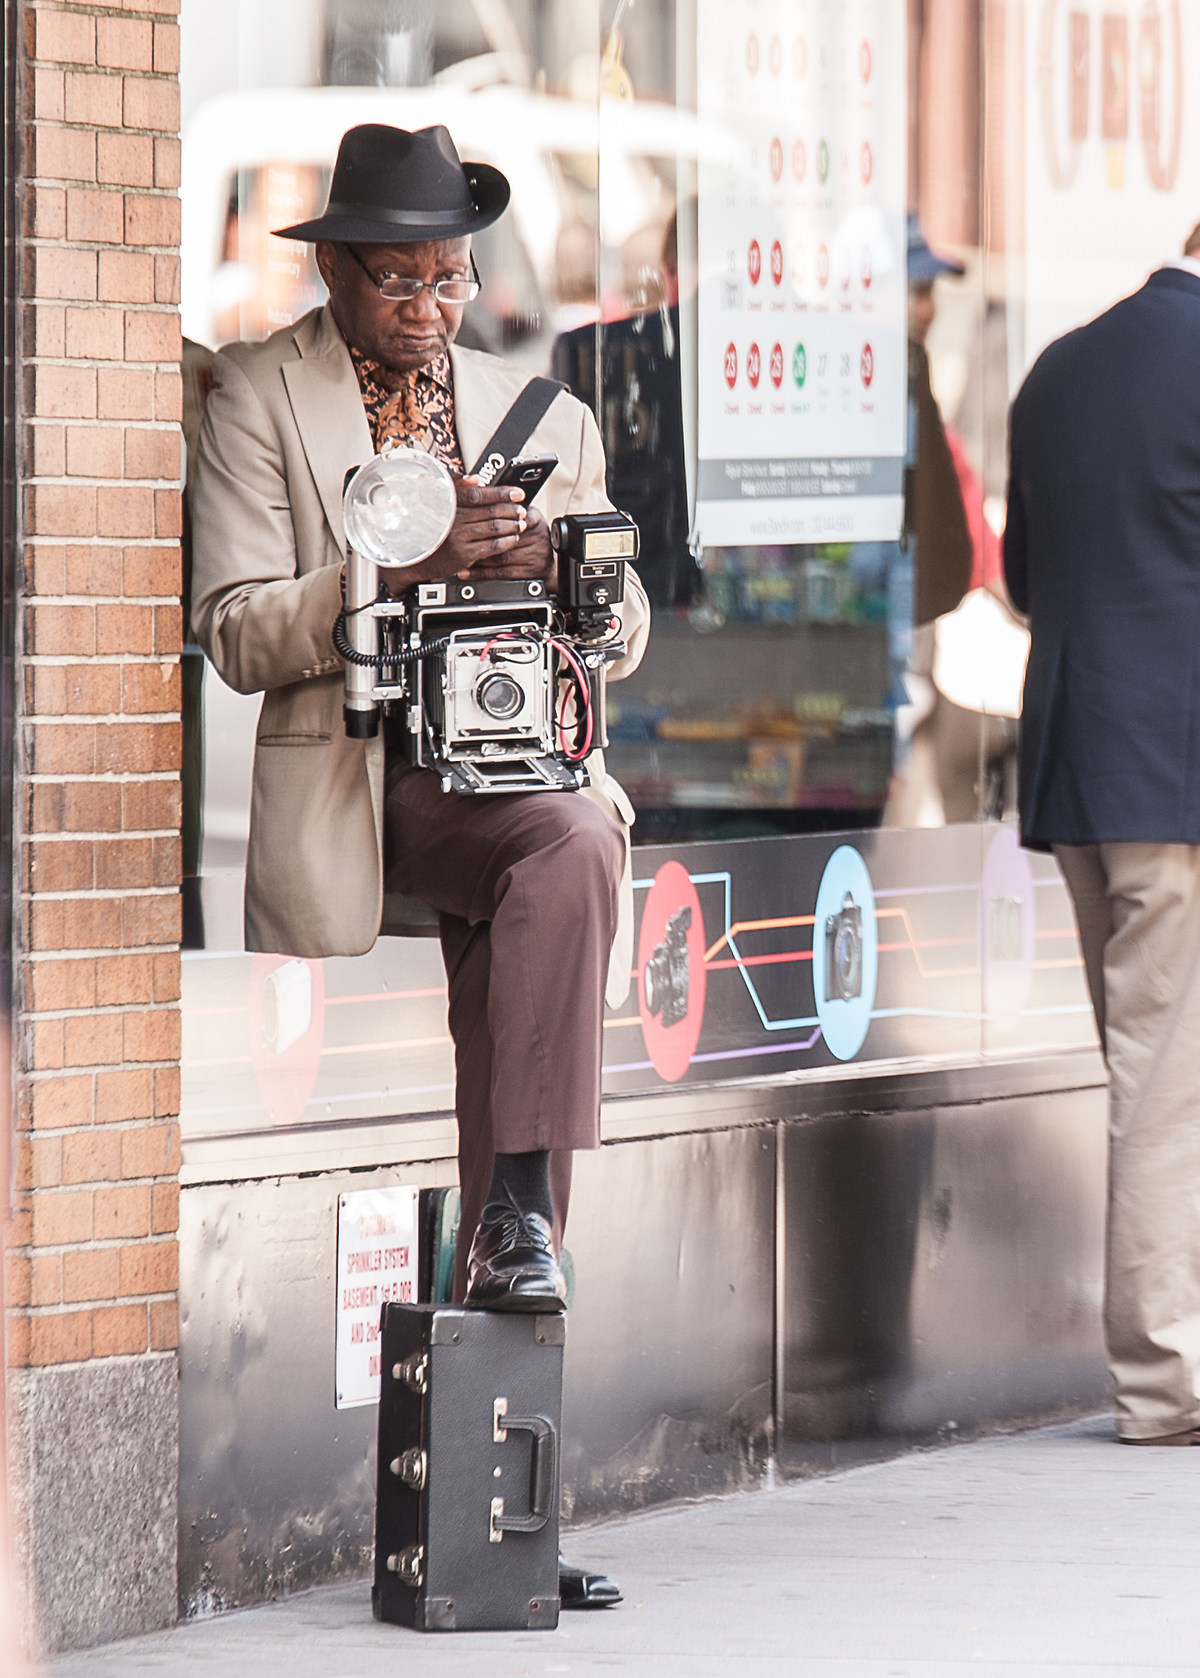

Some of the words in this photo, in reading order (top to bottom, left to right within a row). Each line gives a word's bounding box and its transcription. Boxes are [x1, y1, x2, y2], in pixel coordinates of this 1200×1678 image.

[478, 452, 506, 487] Can
[347, 1249, 382, 1275] SPRINKLER
[384, 1246, 410, 1270] SYSTEM
[392, 1280, 412, 1303] FLOOR
[351, 1322, 364, 1344] AND
[369, 1354, 382, 1377] ON
